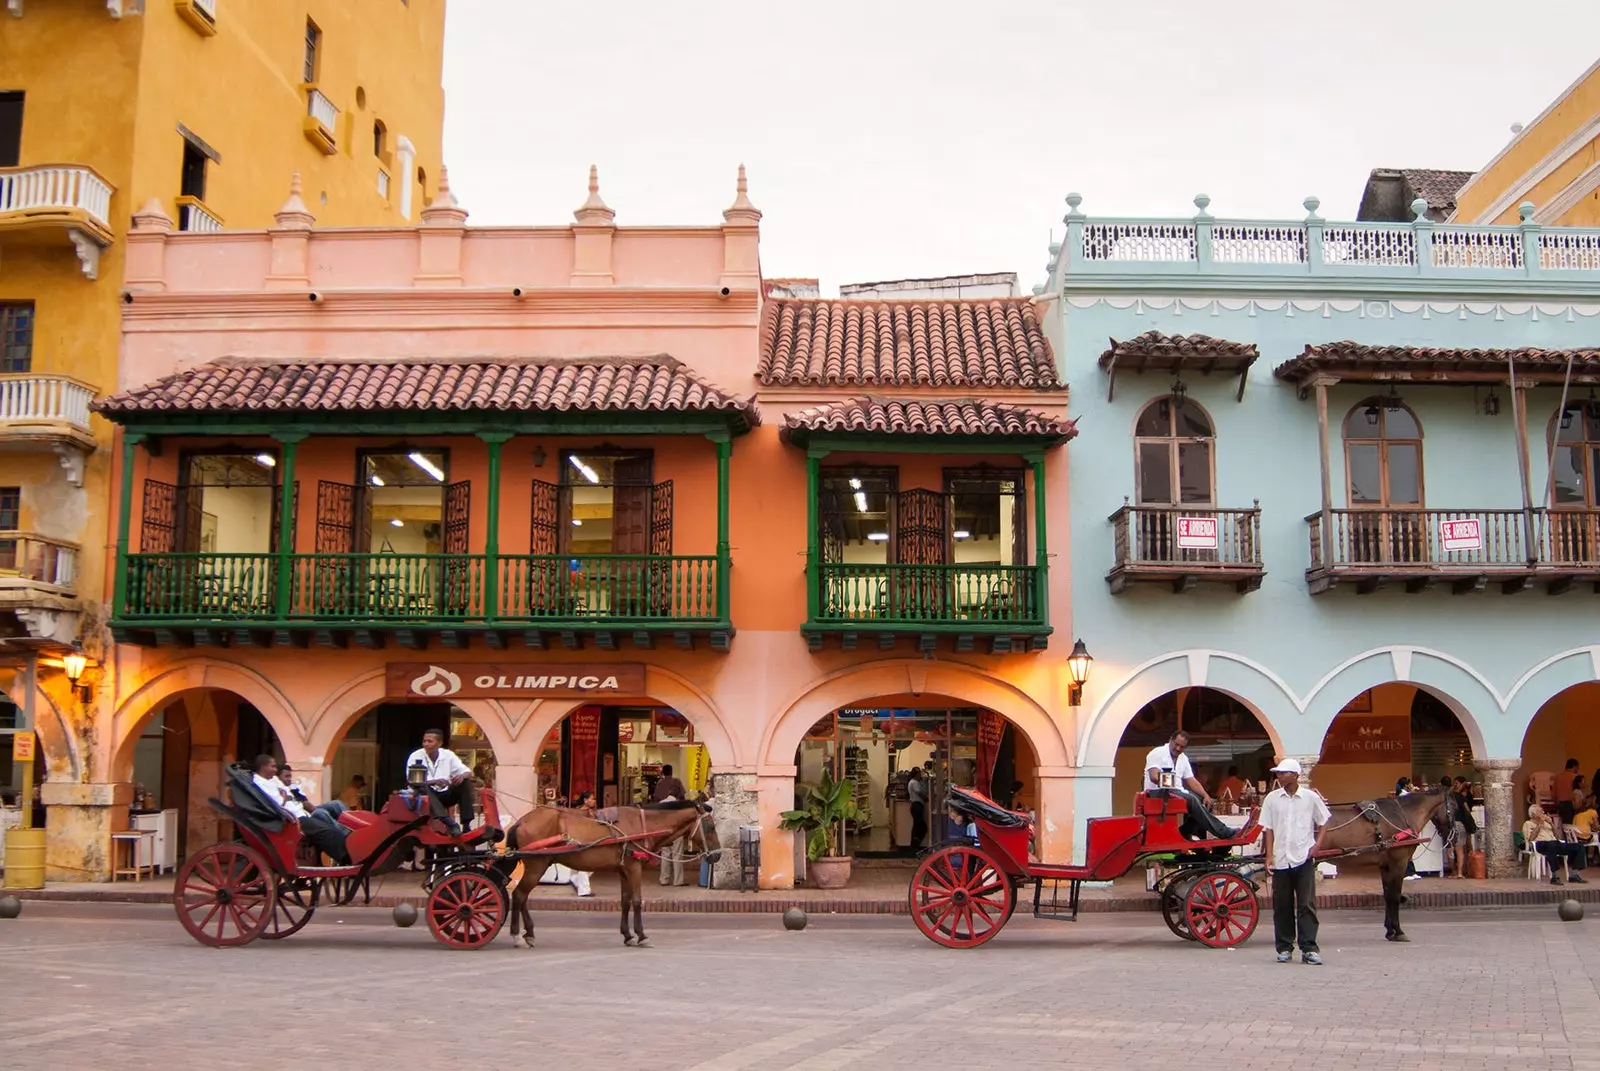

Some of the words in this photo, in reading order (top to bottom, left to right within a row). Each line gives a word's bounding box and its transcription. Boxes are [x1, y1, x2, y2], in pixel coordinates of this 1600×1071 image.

[1179, 520, 1188, 536] SE
[1443, 523, 1452, 539] SE
[474, 675, 619, 689] OLIMPICA
[1364, 740, 1404, 751] COCHES
